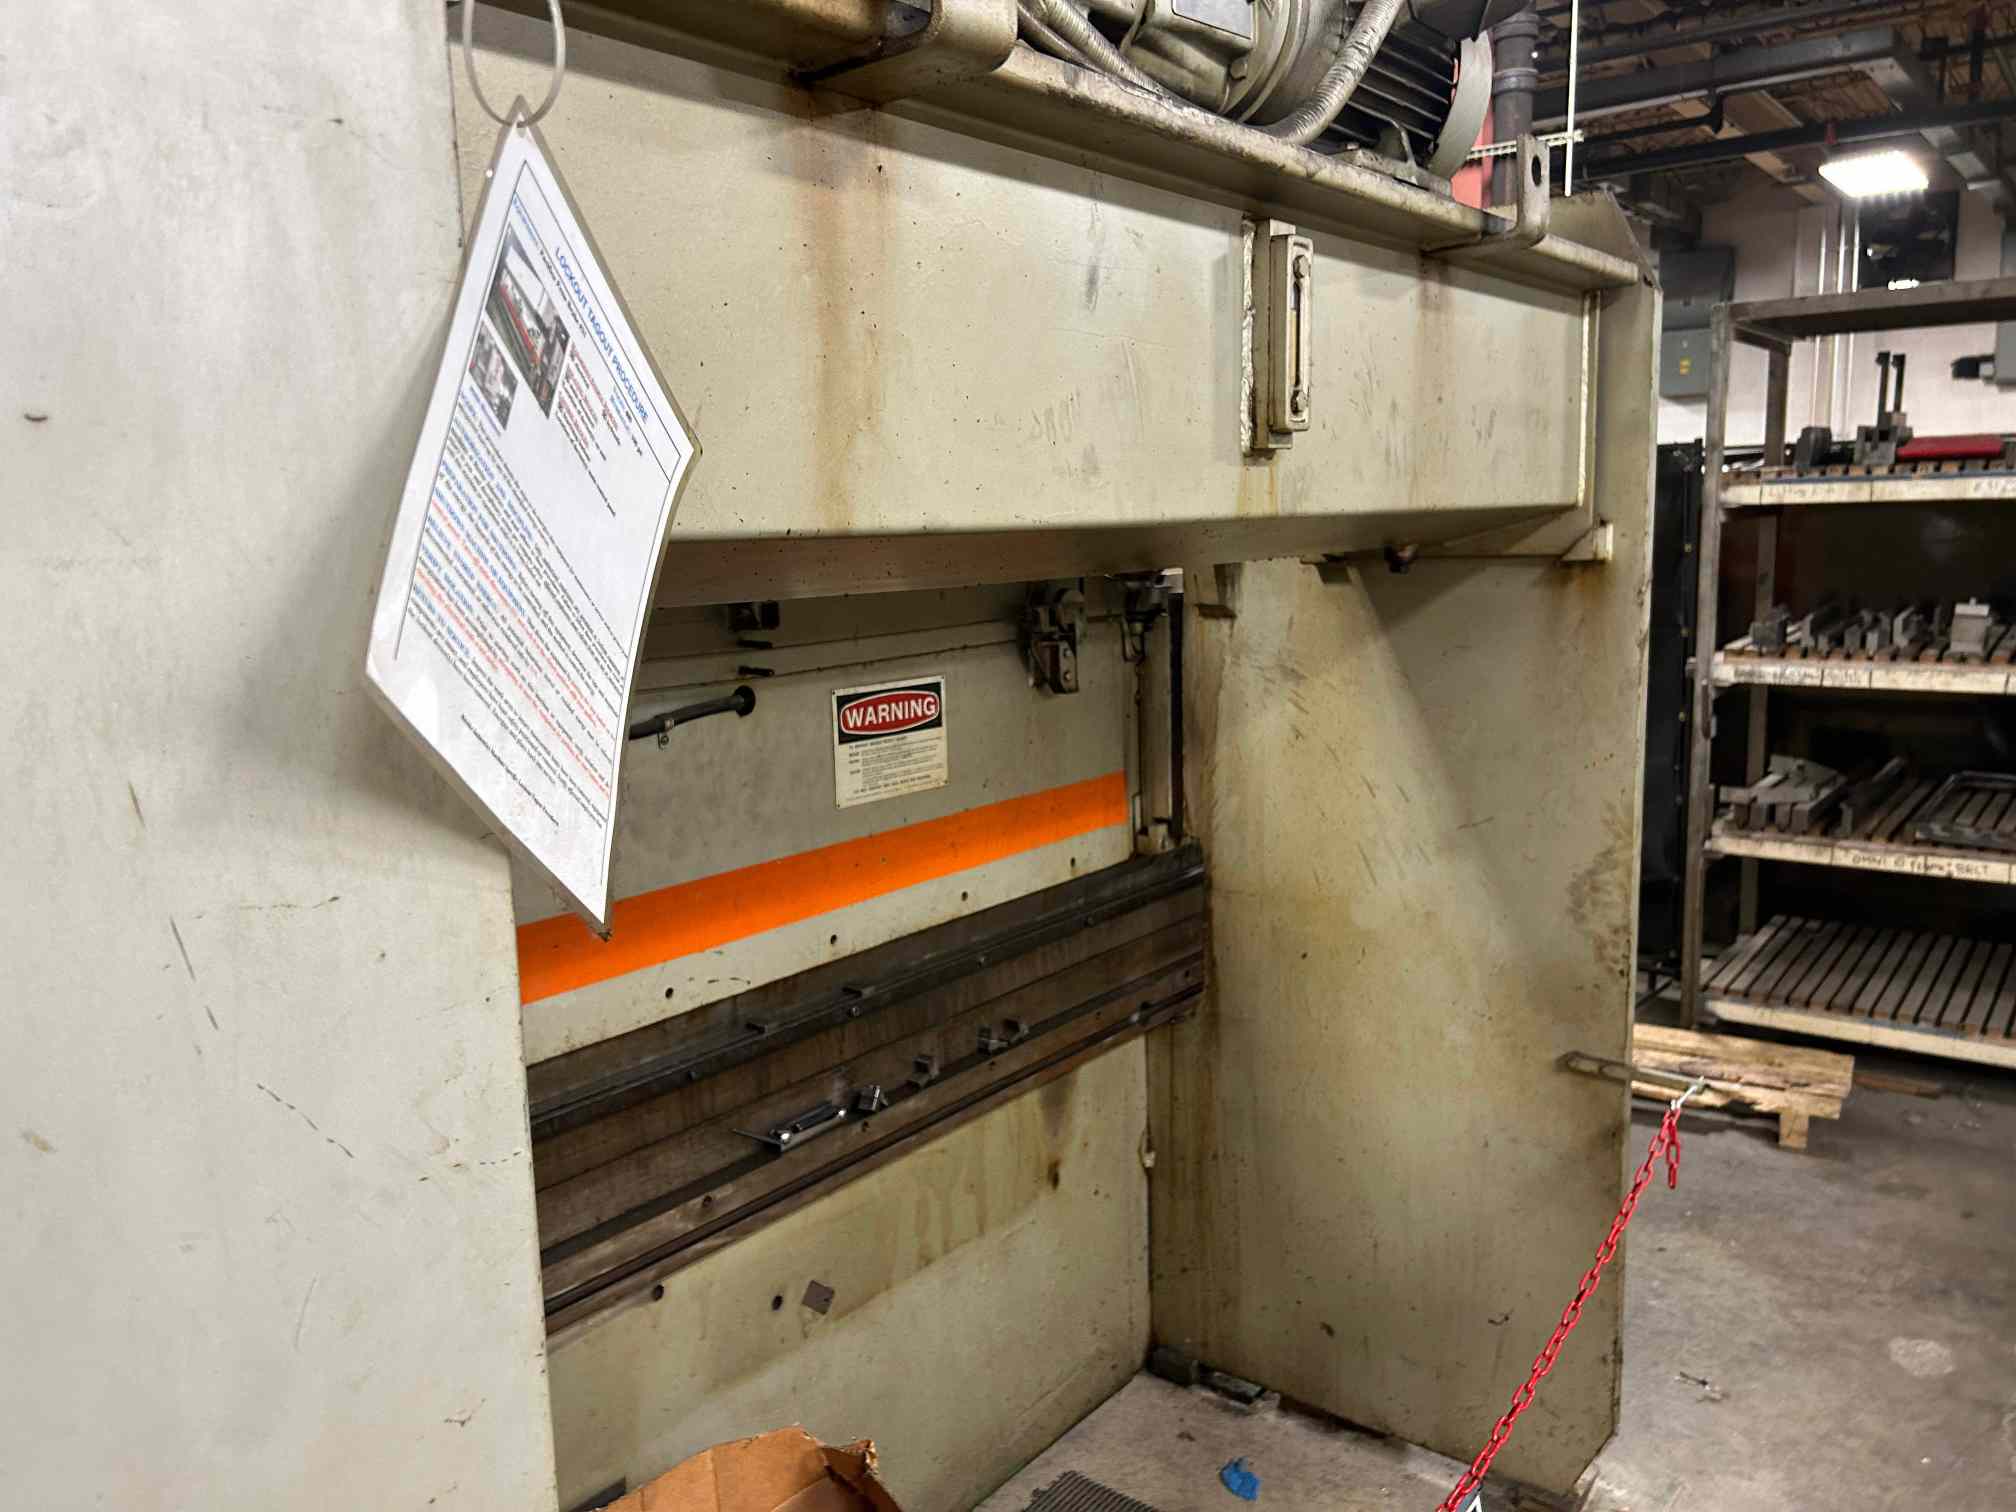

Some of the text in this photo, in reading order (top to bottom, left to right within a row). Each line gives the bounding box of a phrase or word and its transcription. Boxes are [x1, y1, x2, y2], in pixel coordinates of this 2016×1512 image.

[556, 247, 588, 309] LOCKOUT
[586, 307, 614, 357] TAGOUT
[611, 354, 649, 425] PROCEDURE
[845, 697, 936, 728] WARNING
